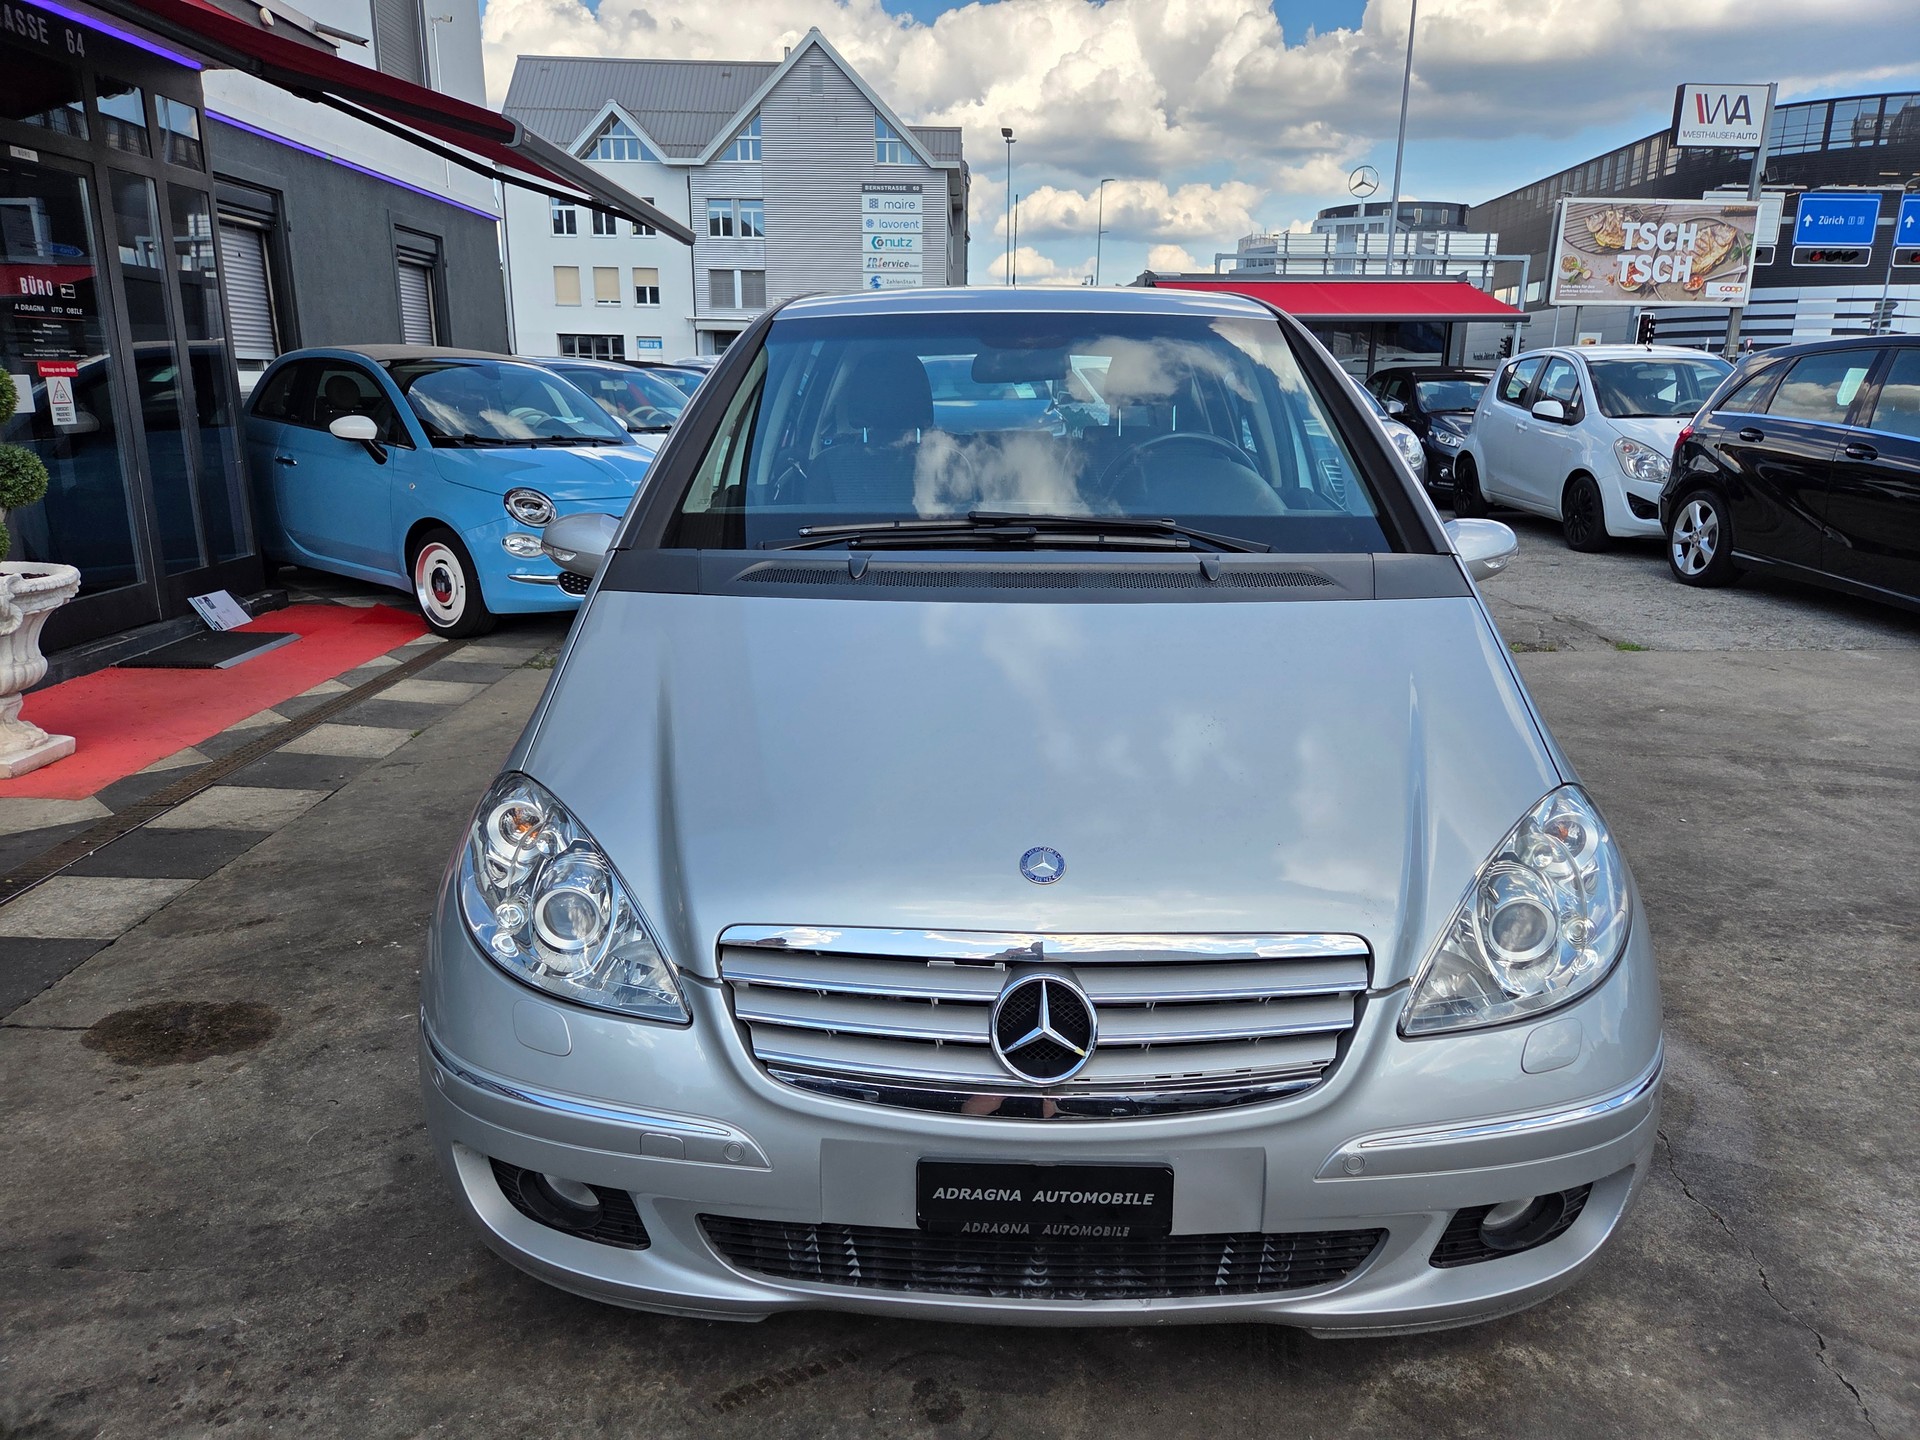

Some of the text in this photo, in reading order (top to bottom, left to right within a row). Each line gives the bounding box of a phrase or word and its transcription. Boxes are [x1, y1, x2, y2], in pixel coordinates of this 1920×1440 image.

[0, 4, 86, 58] ASSE 64
[884, 198, 916, 210] maire
[879, 218, 920, 229] lavorent
[1818, 215, 1844, 225] Zürich
[1622, 222, 1698, 251] TSCH
[1616, 254, 1693, 283] TSCH
[19, 275, 54, 296] BÜRO
[1720, 286, 1742, 294] coop
[932, 1187, 1155, 1206] ADRAGNA AUTOMOBILE
[961, 1222, 1131, 1238] ADRAGNA AUTOMOBILE
